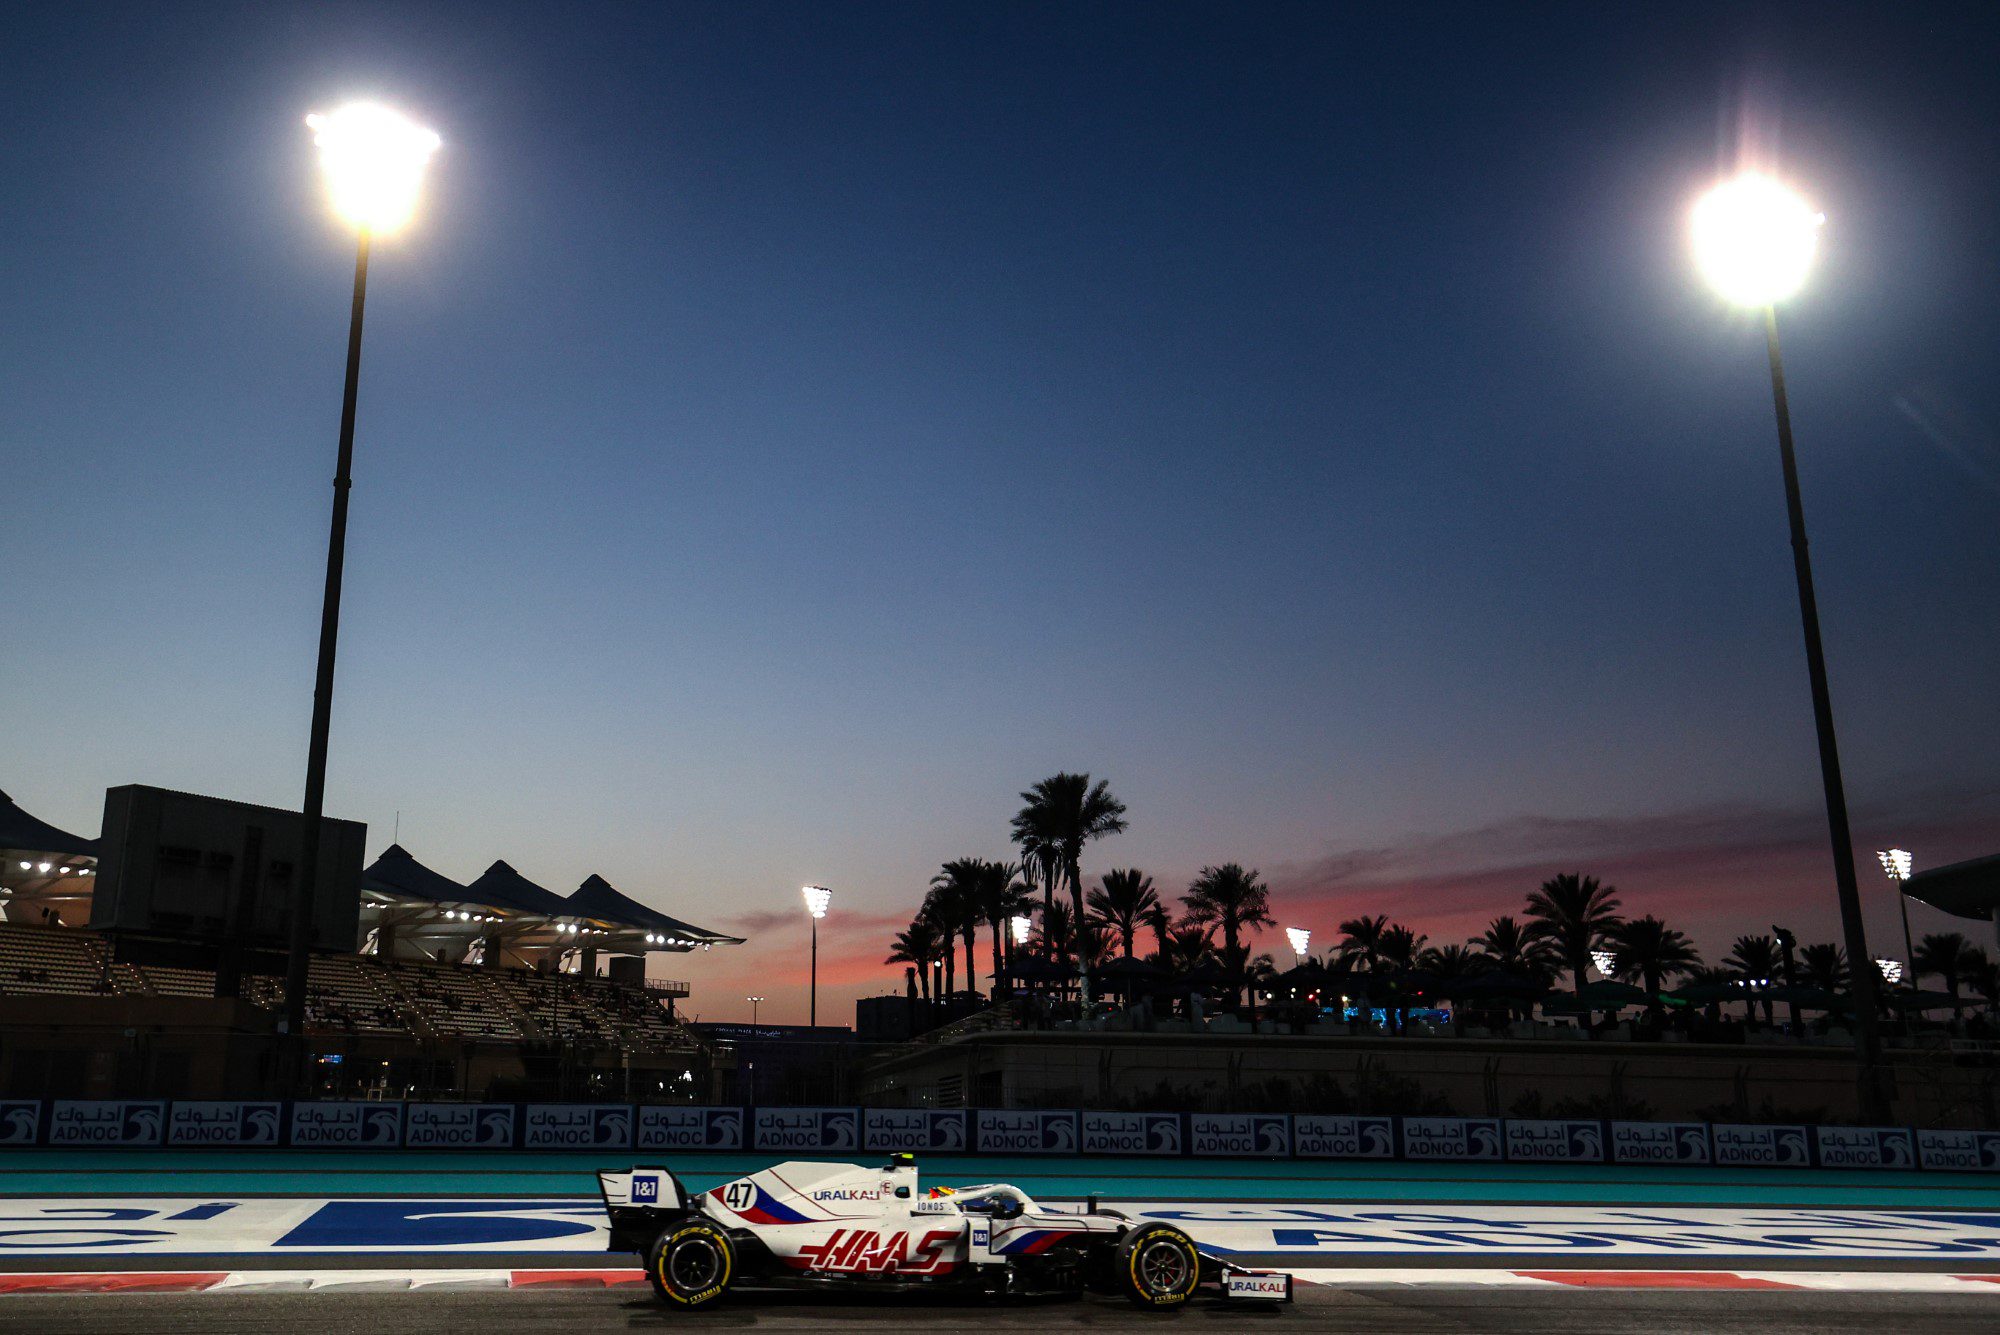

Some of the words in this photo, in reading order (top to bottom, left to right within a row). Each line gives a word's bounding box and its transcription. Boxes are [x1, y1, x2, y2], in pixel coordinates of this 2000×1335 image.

[54, 1127, 118, 1141] ADNOC
[173, 1128, 236, 1141] ADNOC
[295, 1129, 358, 1142] ADNOC
[411, 1129, 472, 1143] ADNOC
[530, 1130, 590, 1144] ADNOC
[642, 1131, 702, 1144] ADNOC
[760, 1132, 817, 1147] ADNOC
[868, 1134, 926, 1147] ADNOC
[982, 1134, 1038, 1148] ADNOC
[1087, 1137, 1142, 1150] ADNOC
[1196, 1139, 1251, 1152] ADNOC
[1300, 1140, 1355, 1153] ADNOC
[1409, 1142, 1464, 1156] ADNOC
[1512, 1144, 1566, 1157] ADNOC
[1619, 1146, 1673, 1159] ADNOC
[1720, 1148, 1773, 1161] ADNOC
[1825, 1150, 1878, 1164] ADNOC
[1925, 1154, 1976, 1167] ADNOC
[634, 1182, 656, 1196] 1&1
[814, 1190, 880, 1201] URALKALI
[726, 1184, 752, 1208] 47
[917, 1203, 944, 1211] IONOS
[974, 1233, 987, 1243] 1&1
[1272, 1229, 2000, 1252] ADNO
[798, 1228, 962, 1272] HAAS
[1229, 1282, 1286, 1293] URALKALI
